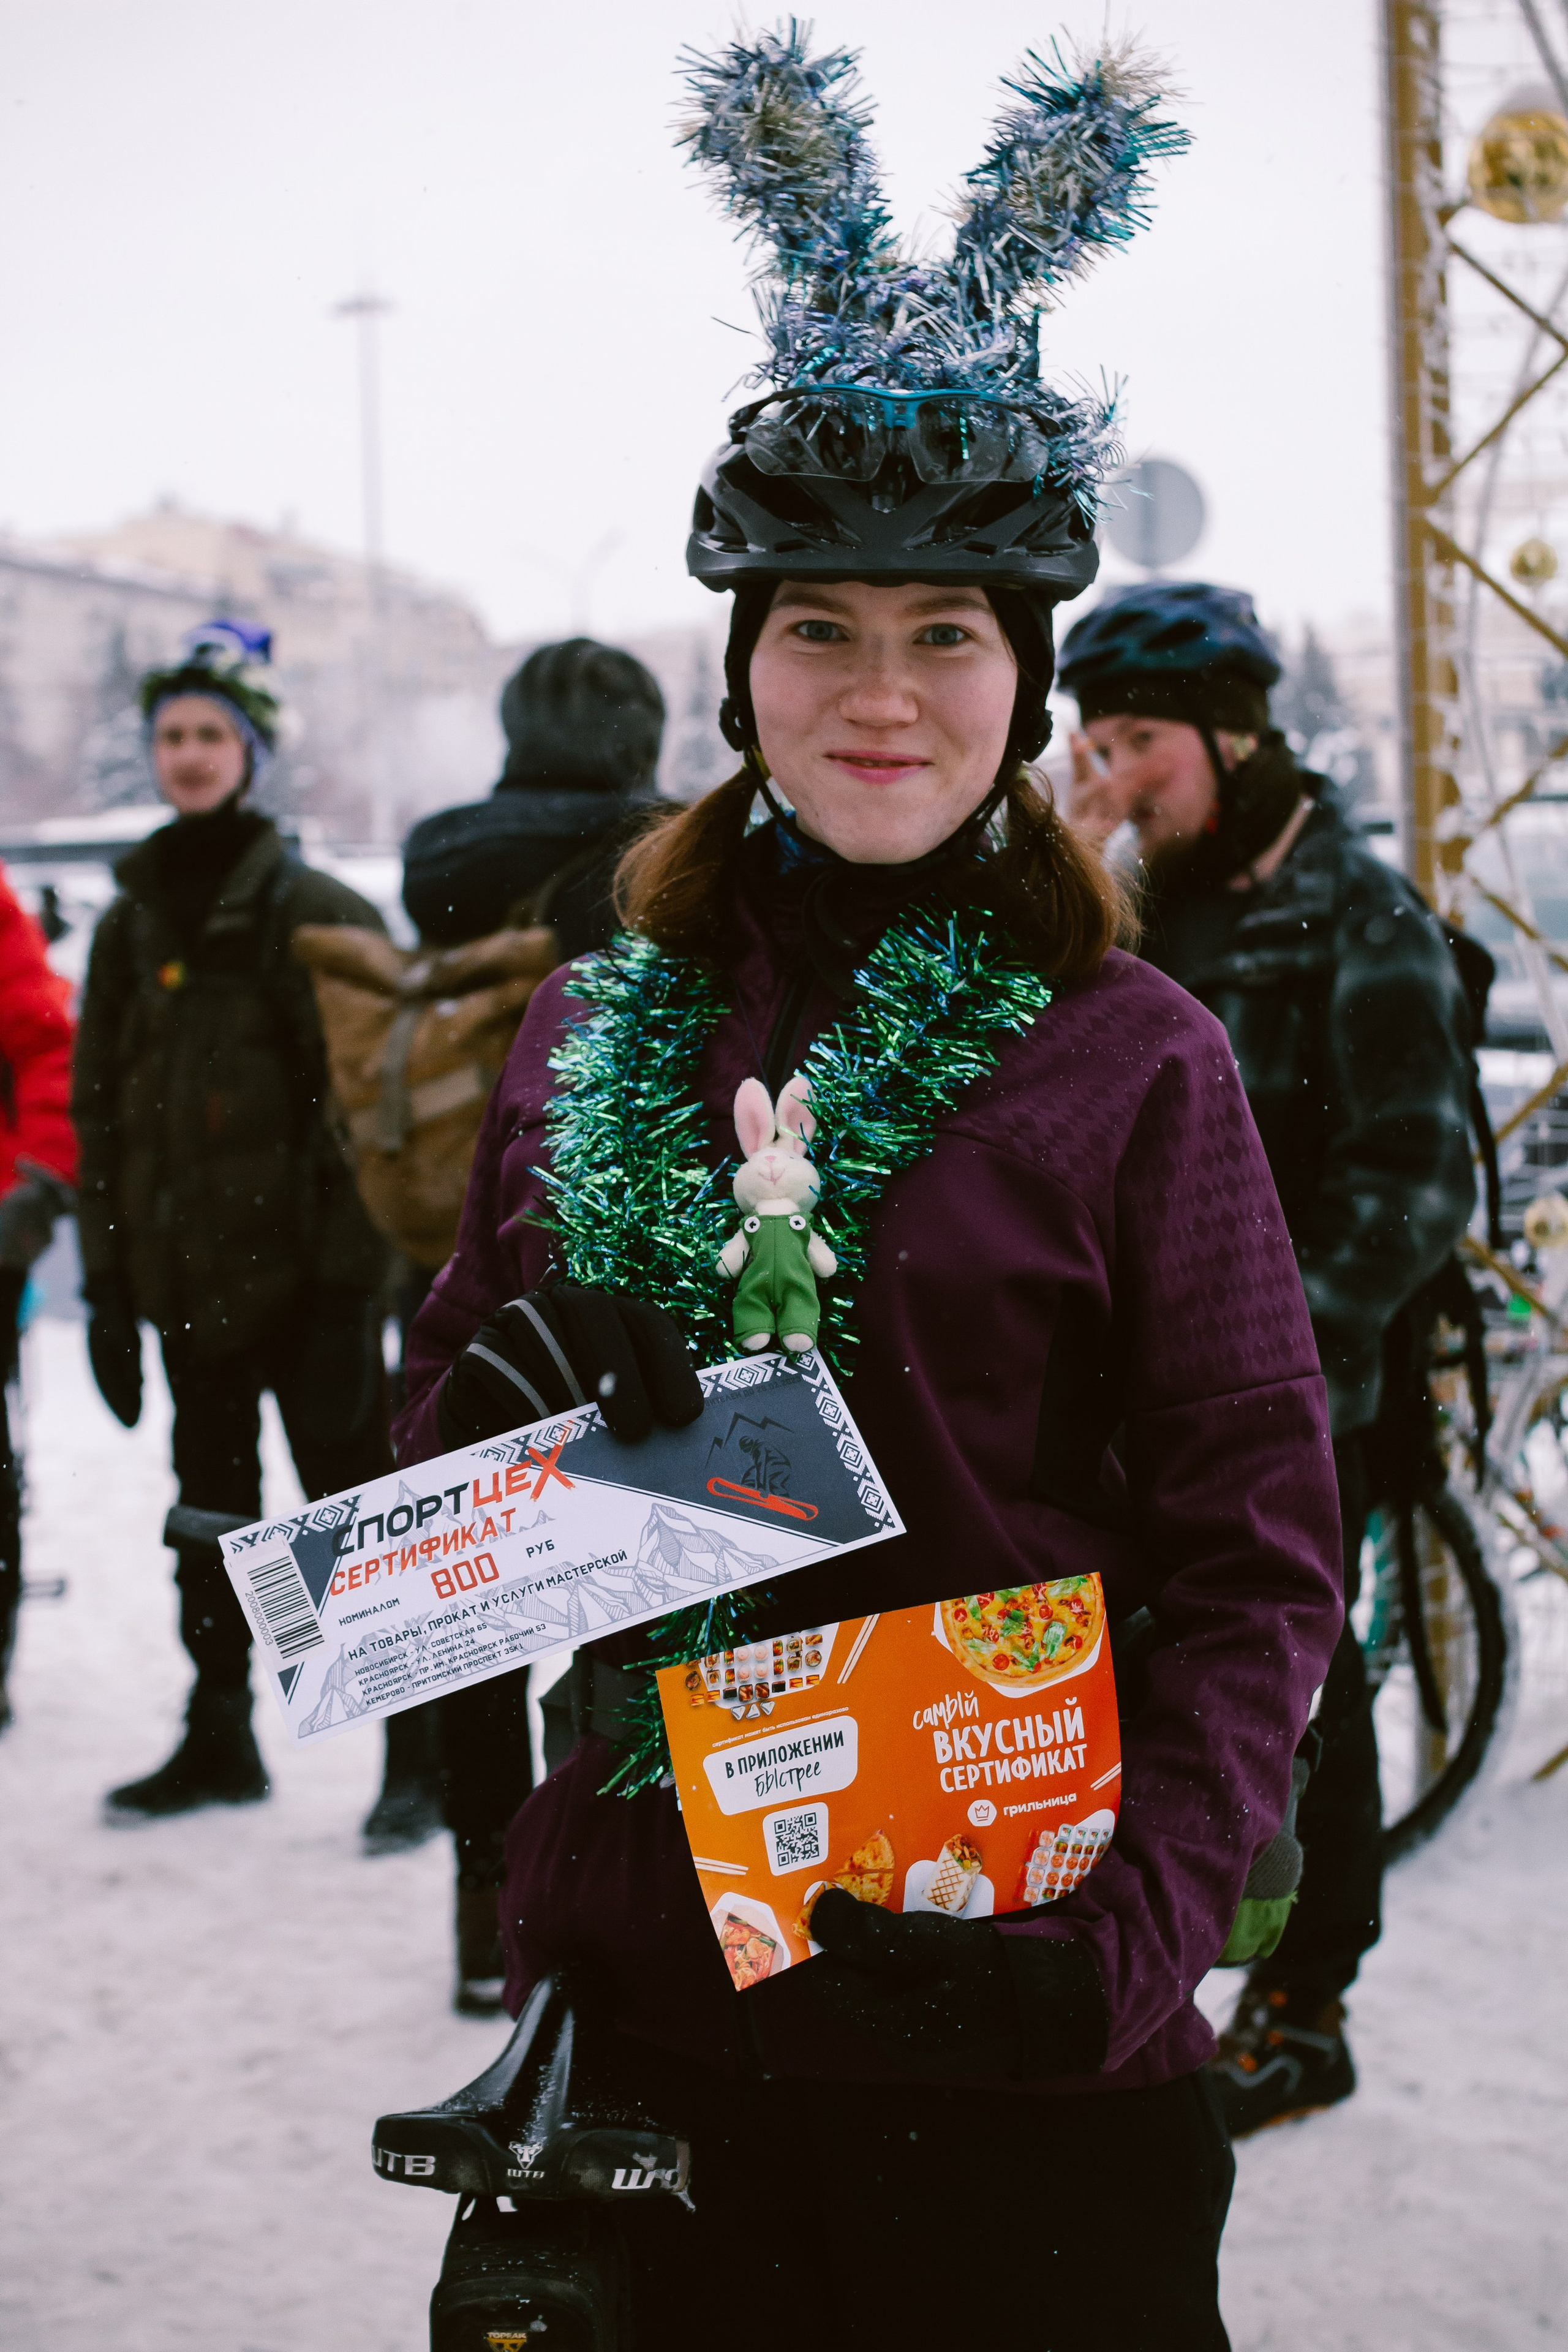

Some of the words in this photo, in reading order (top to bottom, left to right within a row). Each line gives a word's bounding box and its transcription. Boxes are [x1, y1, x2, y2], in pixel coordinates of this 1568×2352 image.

[331, 1419, 576, 1557] СПОРТЦЕХ
[330, 1507, 517, 1597] СЕРТИФИКАТ
[339, 1597, 400, 1626] НОМИНАЛОМ
[430, 1552, 500, 1599] 800
[526, 1539, 555, 1558] РУБ
[347, 1646, 368, 1660] НА
[369, 1625, 427, 1652] ТОВАРЫ,
[428, 1605, 477, 1632] ПРОКАТ
[480, 1600, 490, 1613] И
[491, 1580, 545, 1608] УСЛУГИ
[546, 1549, 628, 1588] МАСТЕРСКОЙ
[245, 1590, 273, 1646] 2008000003
[355, 1651, 409, 1676] НОВОСИБИРСК
[431, 1627, 475, 1648] СОВЕТСКАЯ
[477, 1622, 487, 1631] 65
[358, 1663, 409, 1686] КРАСНОЯРСК
[432, 1643, 464, 1659] ЛЕНИНА
[464, 1638, 475, 1646] 24
[361, 1672, 413, 1696] КРАСНОЯРСК
[448, 1641, 498, 1664] КРАСНОЯРСК
[499, 1627, 535, 1645] РАБОЧИЙ
[535, 1623, 546, 1632] 53
[366, 1687, 405, 1706] КЕМЕРОВО
[412, 1665, 462, 1689] ПРИТОМСКИЙ
[463, 1649, 501, 1670] ПРОСПЕКТ
[725, 1762, 734, 1779] В
[737, 1730, 844, 1775] ПРИЛОЖЕНИИ
[933, 1696, 1085, 1764] ВКУСНЫЙ
[940, 1743, 1087, 1793] СЕРТИФИКАТ
[1003, 1792, 1077, 1817] грильница
